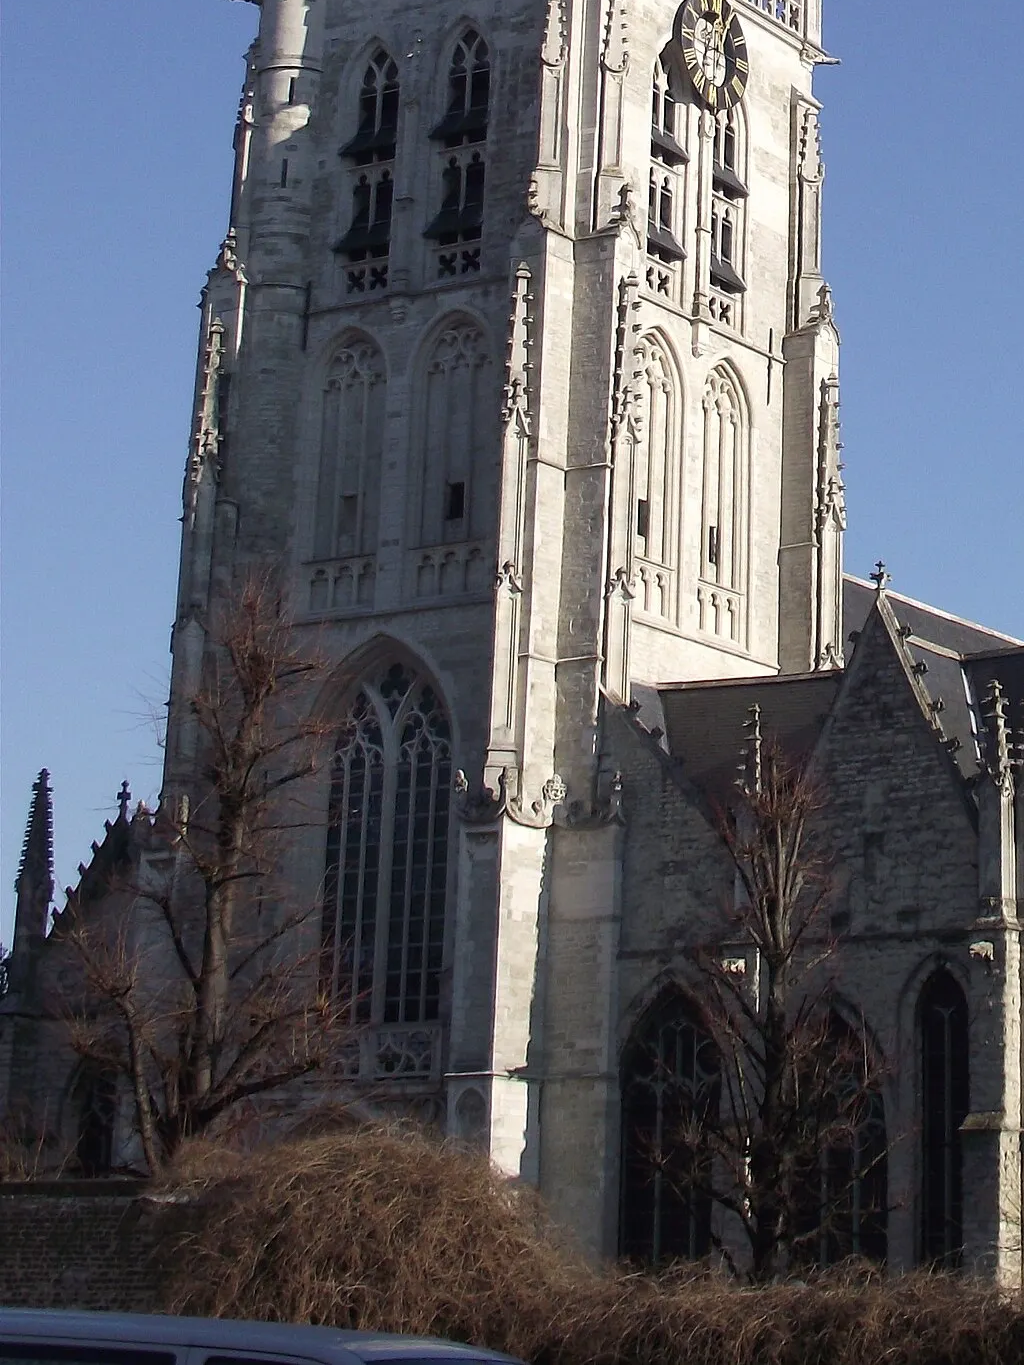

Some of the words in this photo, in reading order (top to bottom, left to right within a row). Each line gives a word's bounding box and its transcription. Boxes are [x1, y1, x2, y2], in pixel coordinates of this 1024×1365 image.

[687, 1, 700, 22] X
[733, 36, 745, 47] II
[736, 57, 749, 74] III
[723, 86, 733, 109] V
